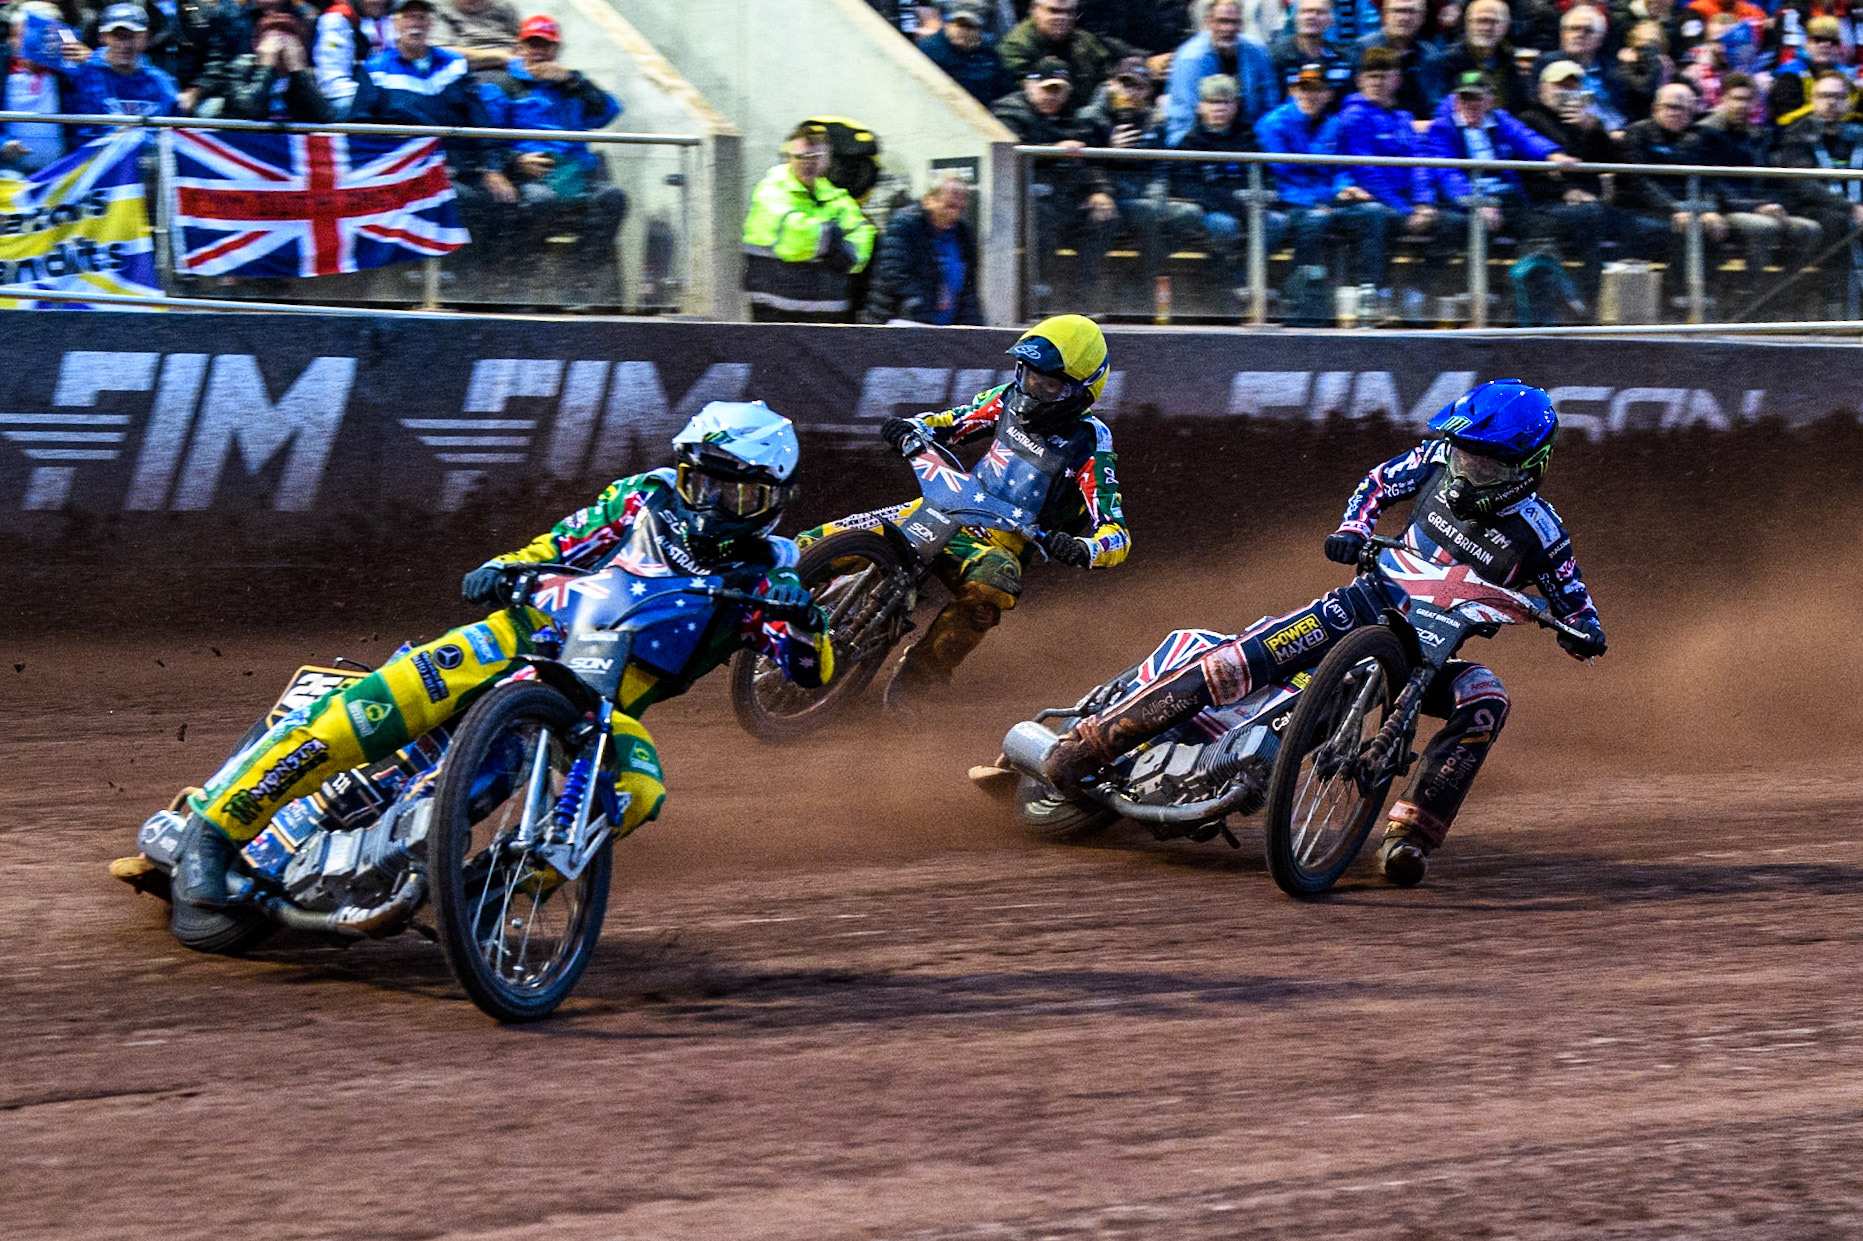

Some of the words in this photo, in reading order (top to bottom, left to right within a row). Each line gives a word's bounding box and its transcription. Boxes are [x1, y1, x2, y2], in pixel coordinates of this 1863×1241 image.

[2, 350, 358, 512] FIM
[1006, 425, 1045, 458] AUSTRALIA
[1427, 511, 1458, 538] GREAT
[1454, 532, 1494, 565] BRITAIN
[1484, 527, 1512, 550] FIM
[1268, 617, 1319, 652] POWER
[1416, 608, 1436, 620] GREAT
[1435, 613, 1461, 629] BRITAIN
[1275, 628, 1325, 662] MAXED
[568, 657, 613, 670] SON
[1141, 692, 1175, 719] Allied
[1147, 694, 1200, 728] obility
